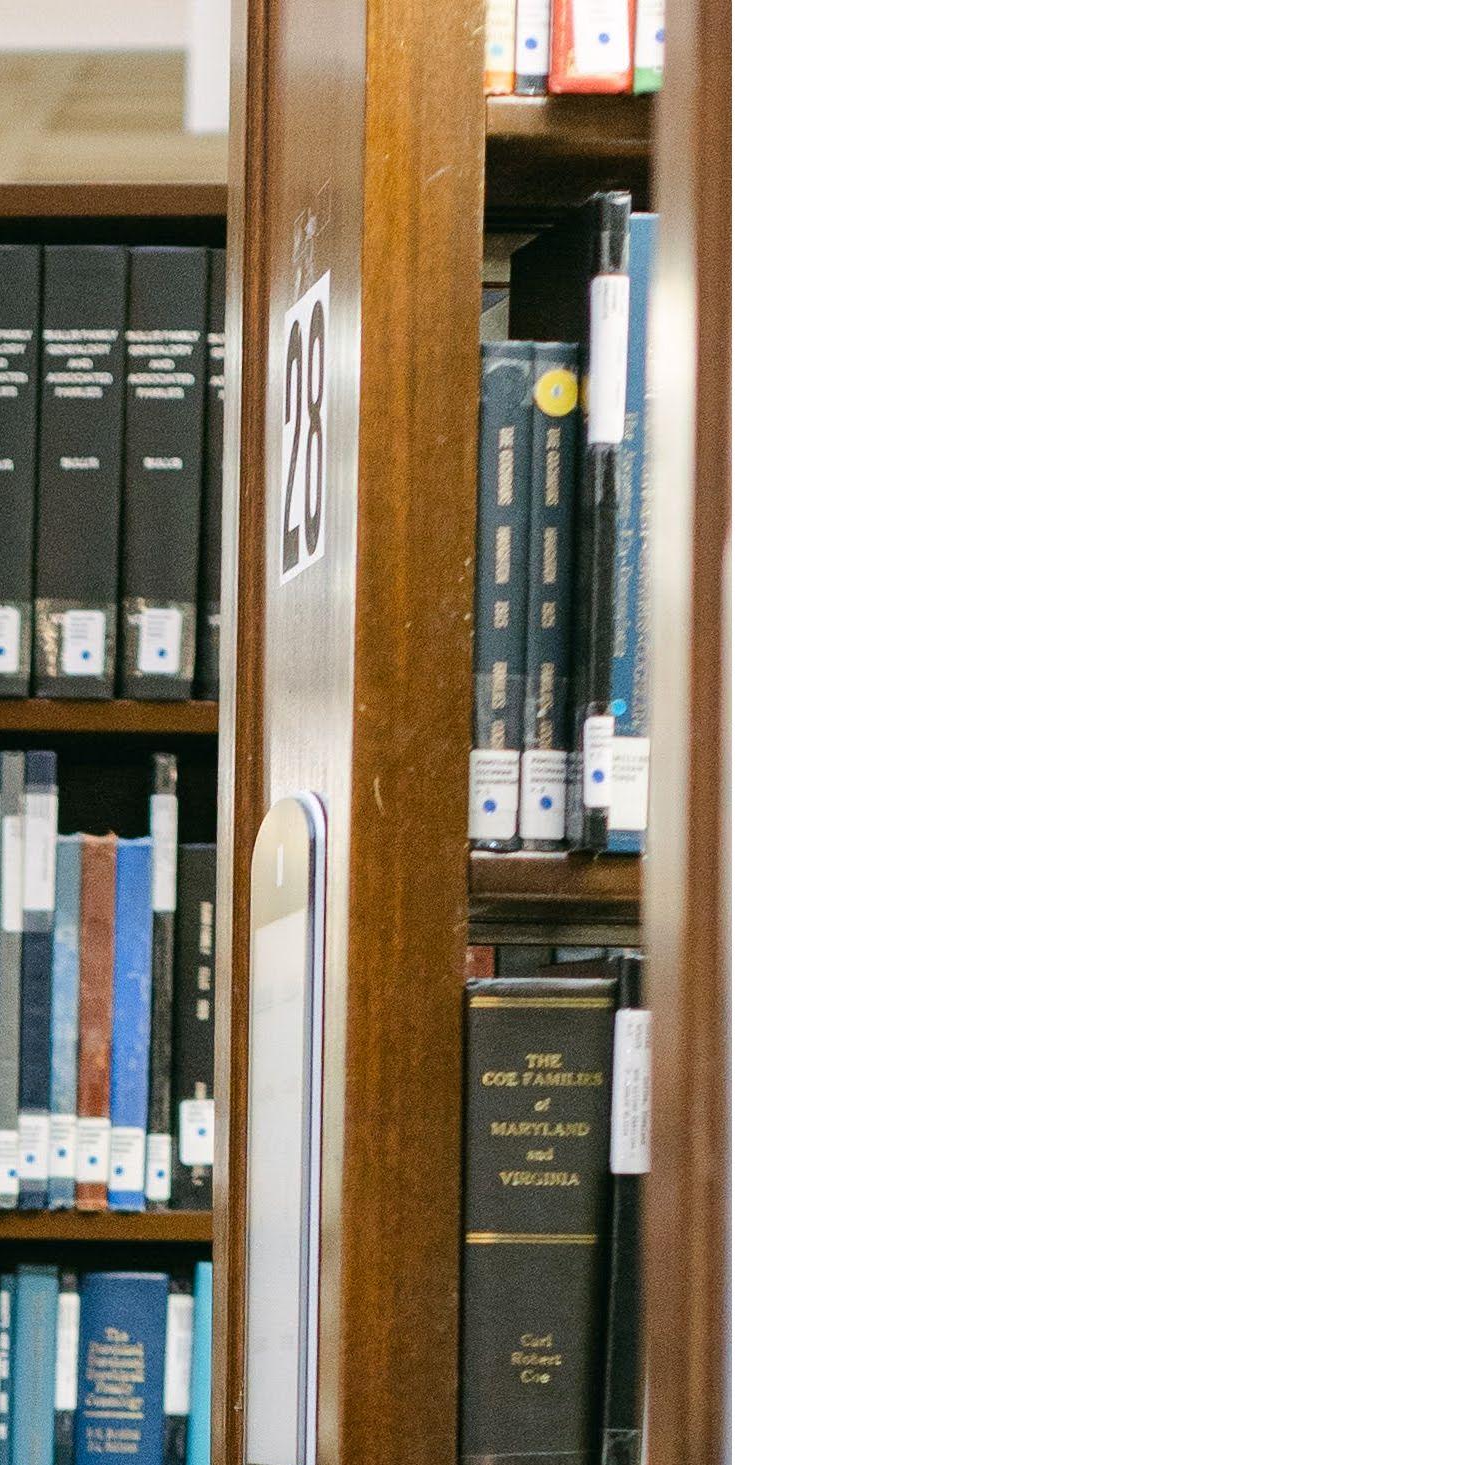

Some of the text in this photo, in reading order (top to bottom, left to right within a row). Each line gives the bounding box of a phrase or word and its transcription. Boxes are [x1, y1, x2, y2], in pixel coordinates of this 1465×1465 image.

[282, 299, 326, 575] 28
[526, 1053, 562, 1069] THE
[482, 1071, 603, 1087] COE FAMILIES
[490, 1122, 591, 1137] MARYLAND
[526, 1148, 555, 1162] and
[498, 1171, 581, 1187] VIRGINIA
